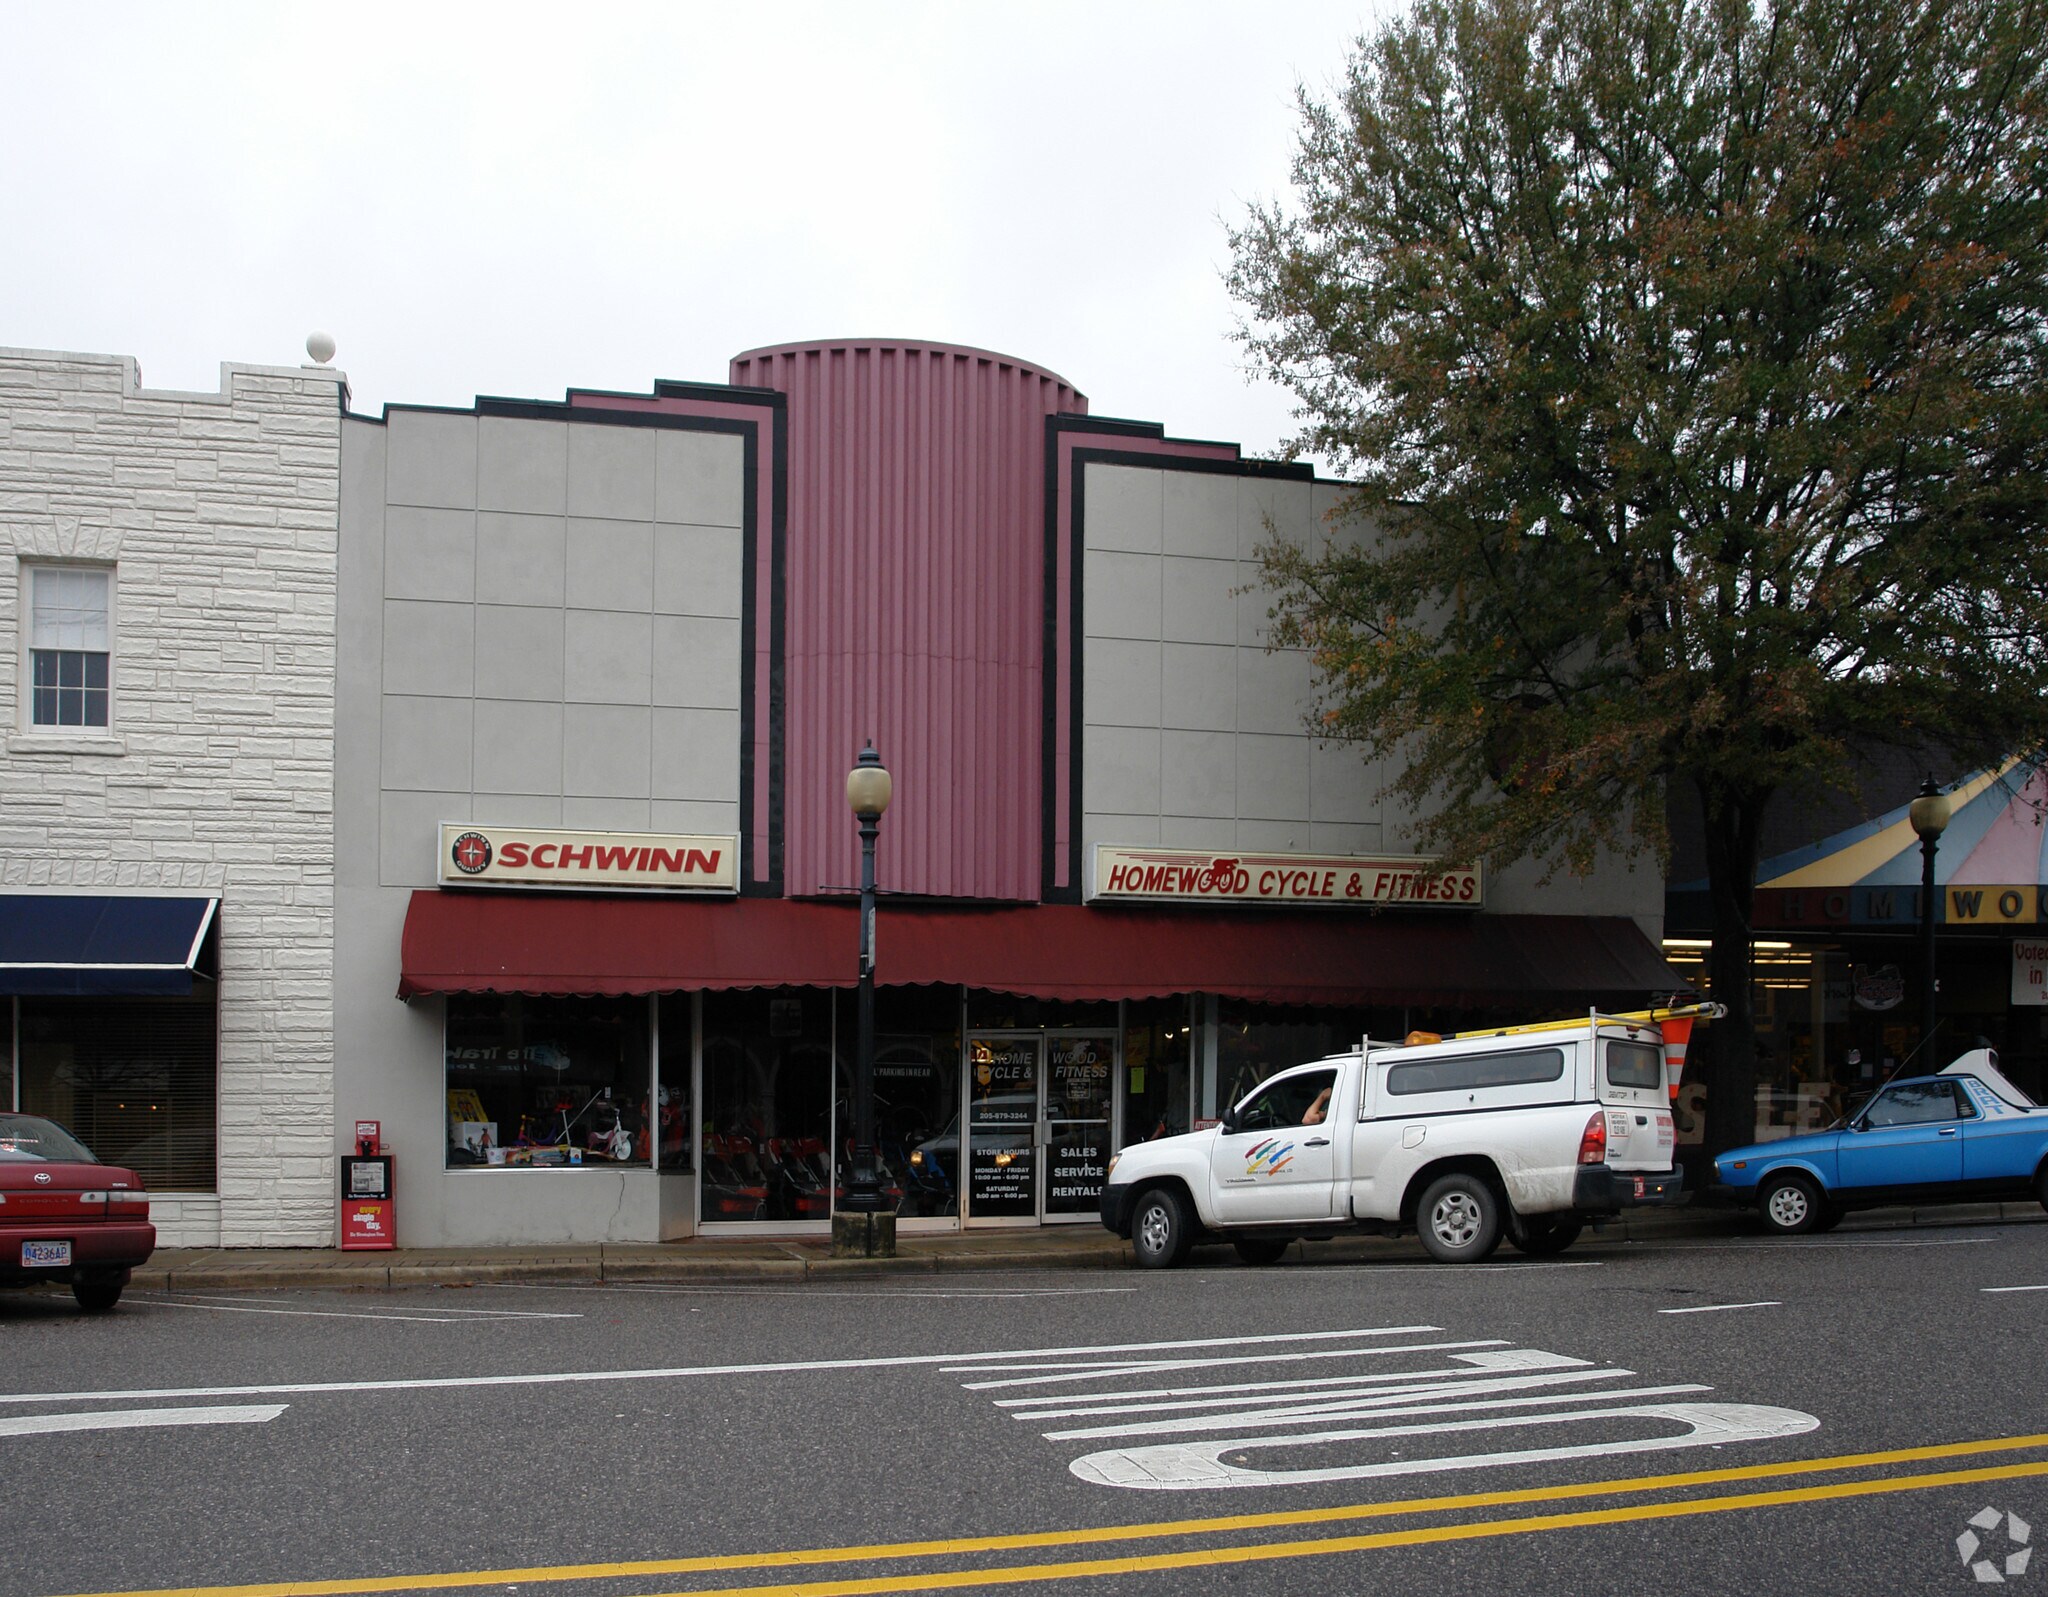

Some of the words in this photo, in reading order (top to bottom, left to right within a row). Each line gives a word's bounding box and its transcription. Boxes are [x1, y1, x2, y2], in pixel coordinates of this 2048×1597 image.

[455, 832, 490, 849] SCHWINN
[497, 842, 721, 874] SCHWINN
[456, 860, 487, 873] QUALITY
[1108, 864, 1250, 894] HOMEWOOD
[1259, 870, 1336, 897] CYCLE
[1345, 872, 1363, 898] &
[1373, 873, 1476, 900] FITNESS
[1783, 890, 2048, 920] HOMWO
[2029, 965, 2043, 985] in
[1053, 1052, 1097, 1065] WOOD
[880, 1068, 905, 1077] PARKING
[906, 1068, 913, 1077] IN
[914, 1068, 930, 1077] REAR
[1023, 1066, 1033, 1079] &
[1055, 1066, 1108, 1078] FITNESS
[1967, 1080, 2003, 1115] BRAT
[1677, 1083, 1832, 1144] SLE
[976, 1148, 1001, 1156] STORE
[1003, 1148, 1030, 1156] HOURS
[1060, 1147, 1098, 1158] SALES
[1054, 1166, 1103, 1177] SERVICE
[1052, 1186, 1102, 1197] RENTALS
[360, 1206, 381, 1215] every
[353, 1213, 375, 1223] single
